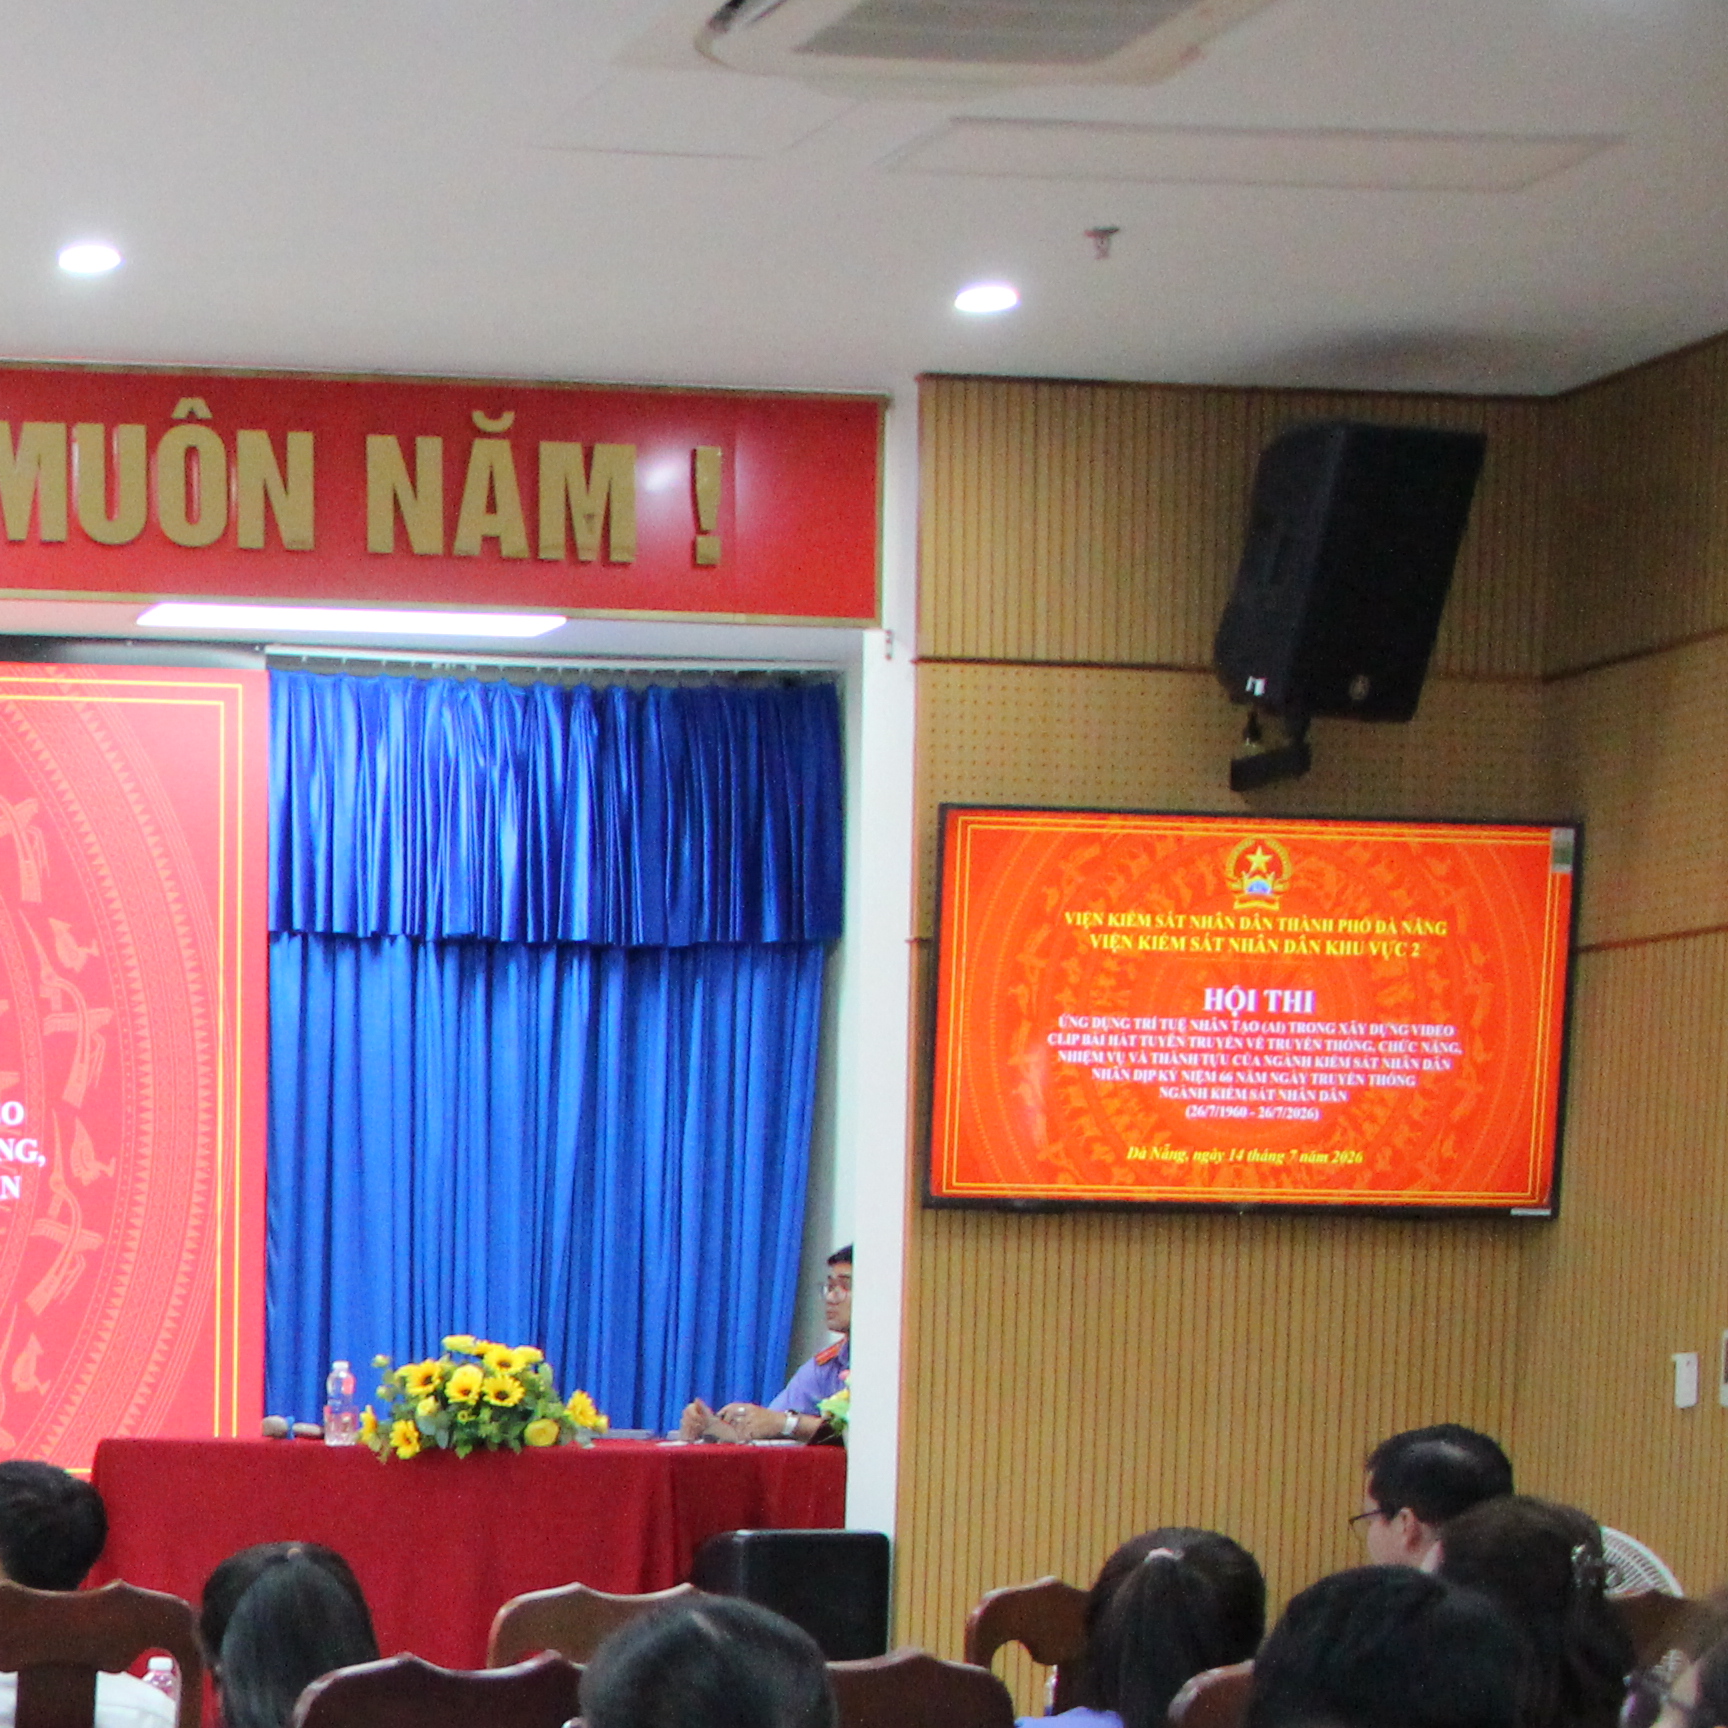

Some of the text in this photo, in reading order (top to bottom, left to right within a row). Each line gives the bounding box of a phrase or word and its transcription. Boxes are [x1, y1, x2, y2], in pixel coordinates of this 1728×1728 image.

[367, 409, 638, 564] NĂM
[1064, 910, 1104, 931] VIỆN
[1154, 909, 1187, 930] SÁT
[1189, 910, 1236, 931] NHÂN
[1239, 911, 1273, 932] DÂN
[1277, 914, 1334, 933] THÀNH
[1089, 931, 1134, 955] VIỆN
[1189, 932, 1226, 953] SÁT
[1228, 933, 1280, 955] NHÂN
[1283, 934, 1321, 956] DÂN
[1325, 939, 1364, 957] KHU
[1411, 941, 1421, 958] 2
[1202, 984, 1313, 1019] HỘI THI
